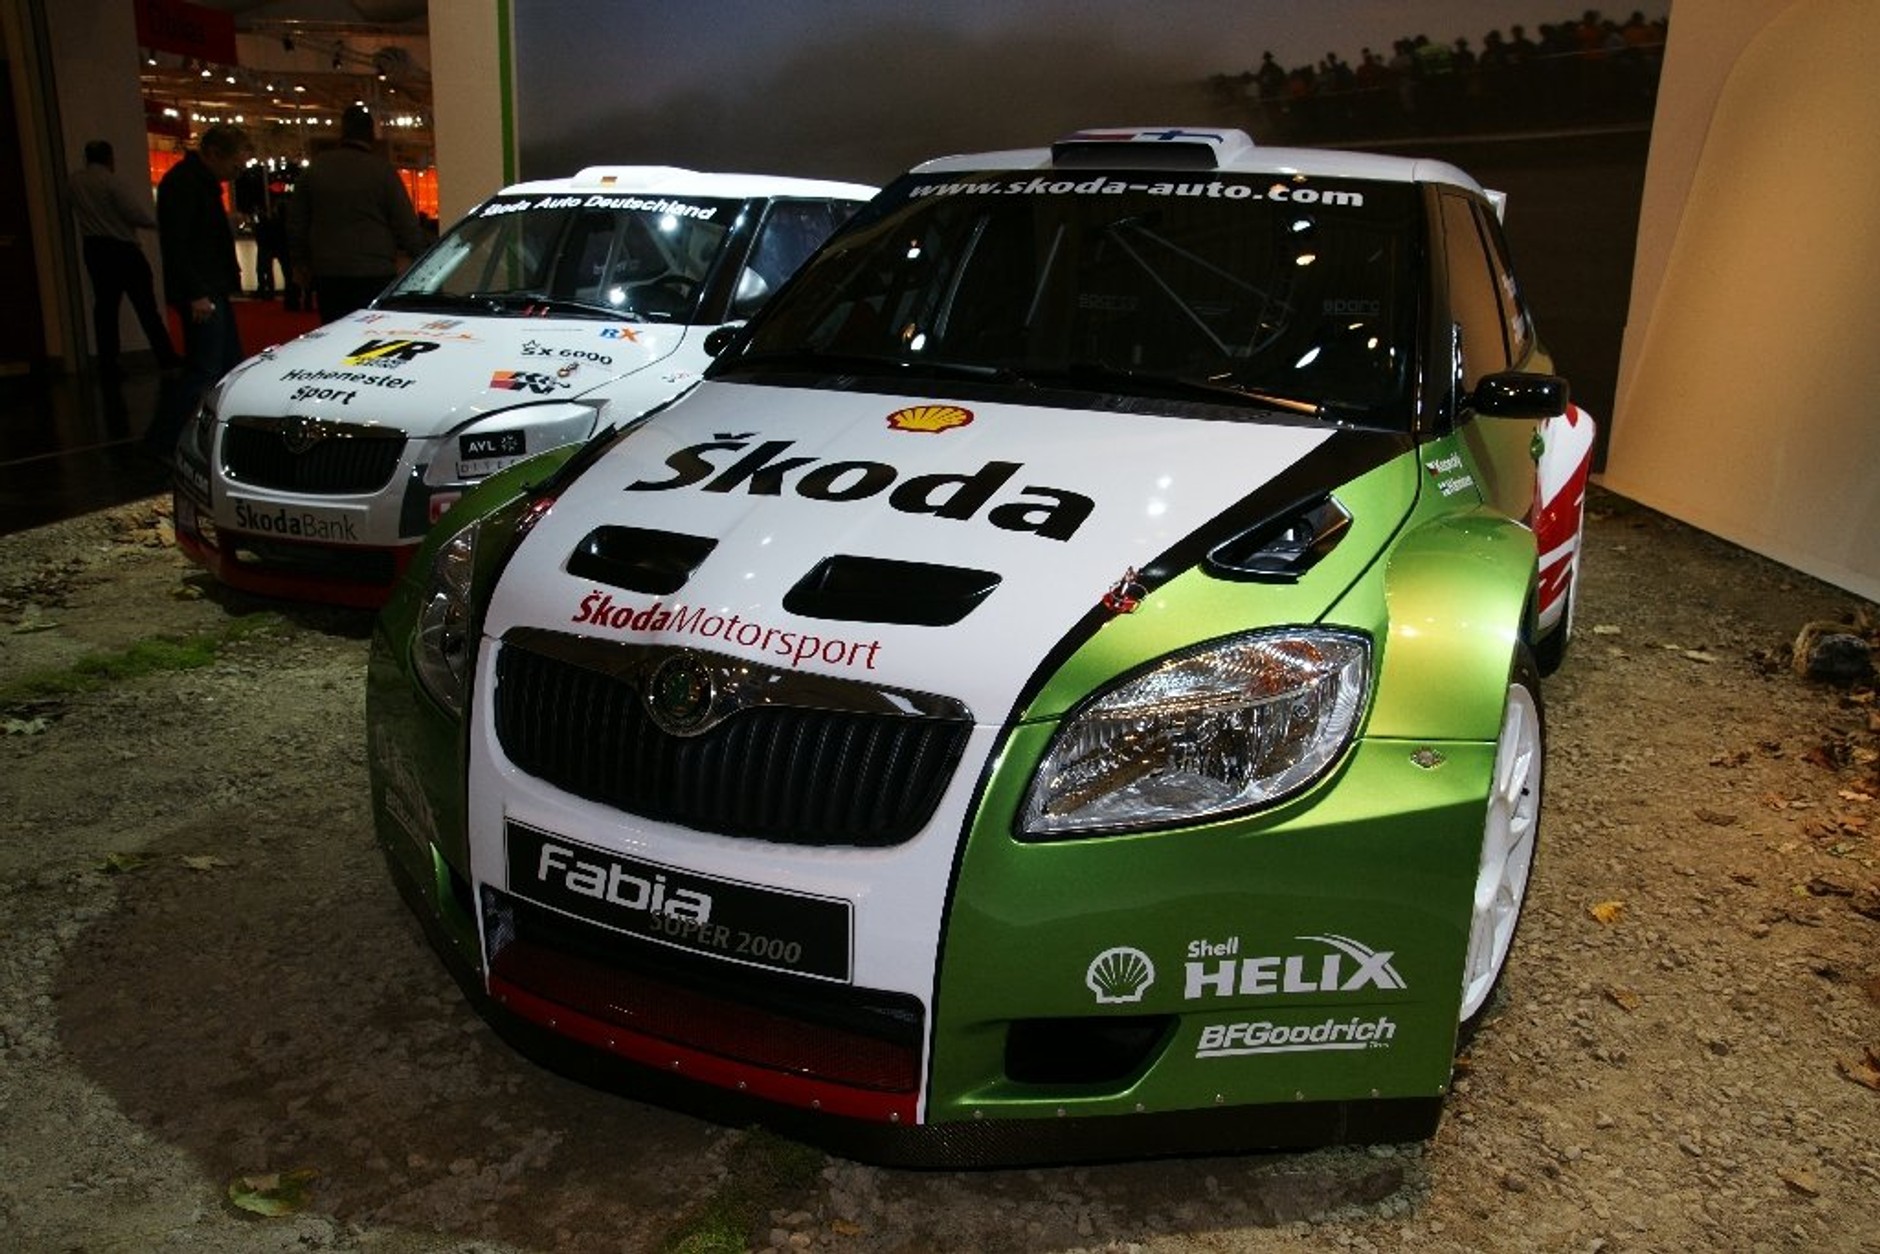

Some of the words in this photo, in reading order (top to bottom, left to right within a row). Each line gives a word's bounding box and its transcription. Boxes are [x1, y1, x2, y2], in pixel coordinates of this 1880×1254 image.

[533, 196, 582, 209] Auto
[583, 194, 718, 220] Deutschland
[909, 176, 1364, 207] www.skoda-auto.com
[559, 349, 613, 366] 6000
[278, 368, 417, 389] Hohenester
[624, 432, 1096, 543] Škoda
[234, 498, 360, 542] ŠkodaBank
[572, 590, 882, 671] ŠkodaMotorsport
[537, 842, 713, 924] Fabia
[648, 908, 730, 950] SUPER
[734, 930, 802, 964] 2000
[1187, 936, 1239, 958] Shell
[1184, 936, 1408, 1000] HELIX
[1200, 1016, 1396, 1050] BFGoodrich
